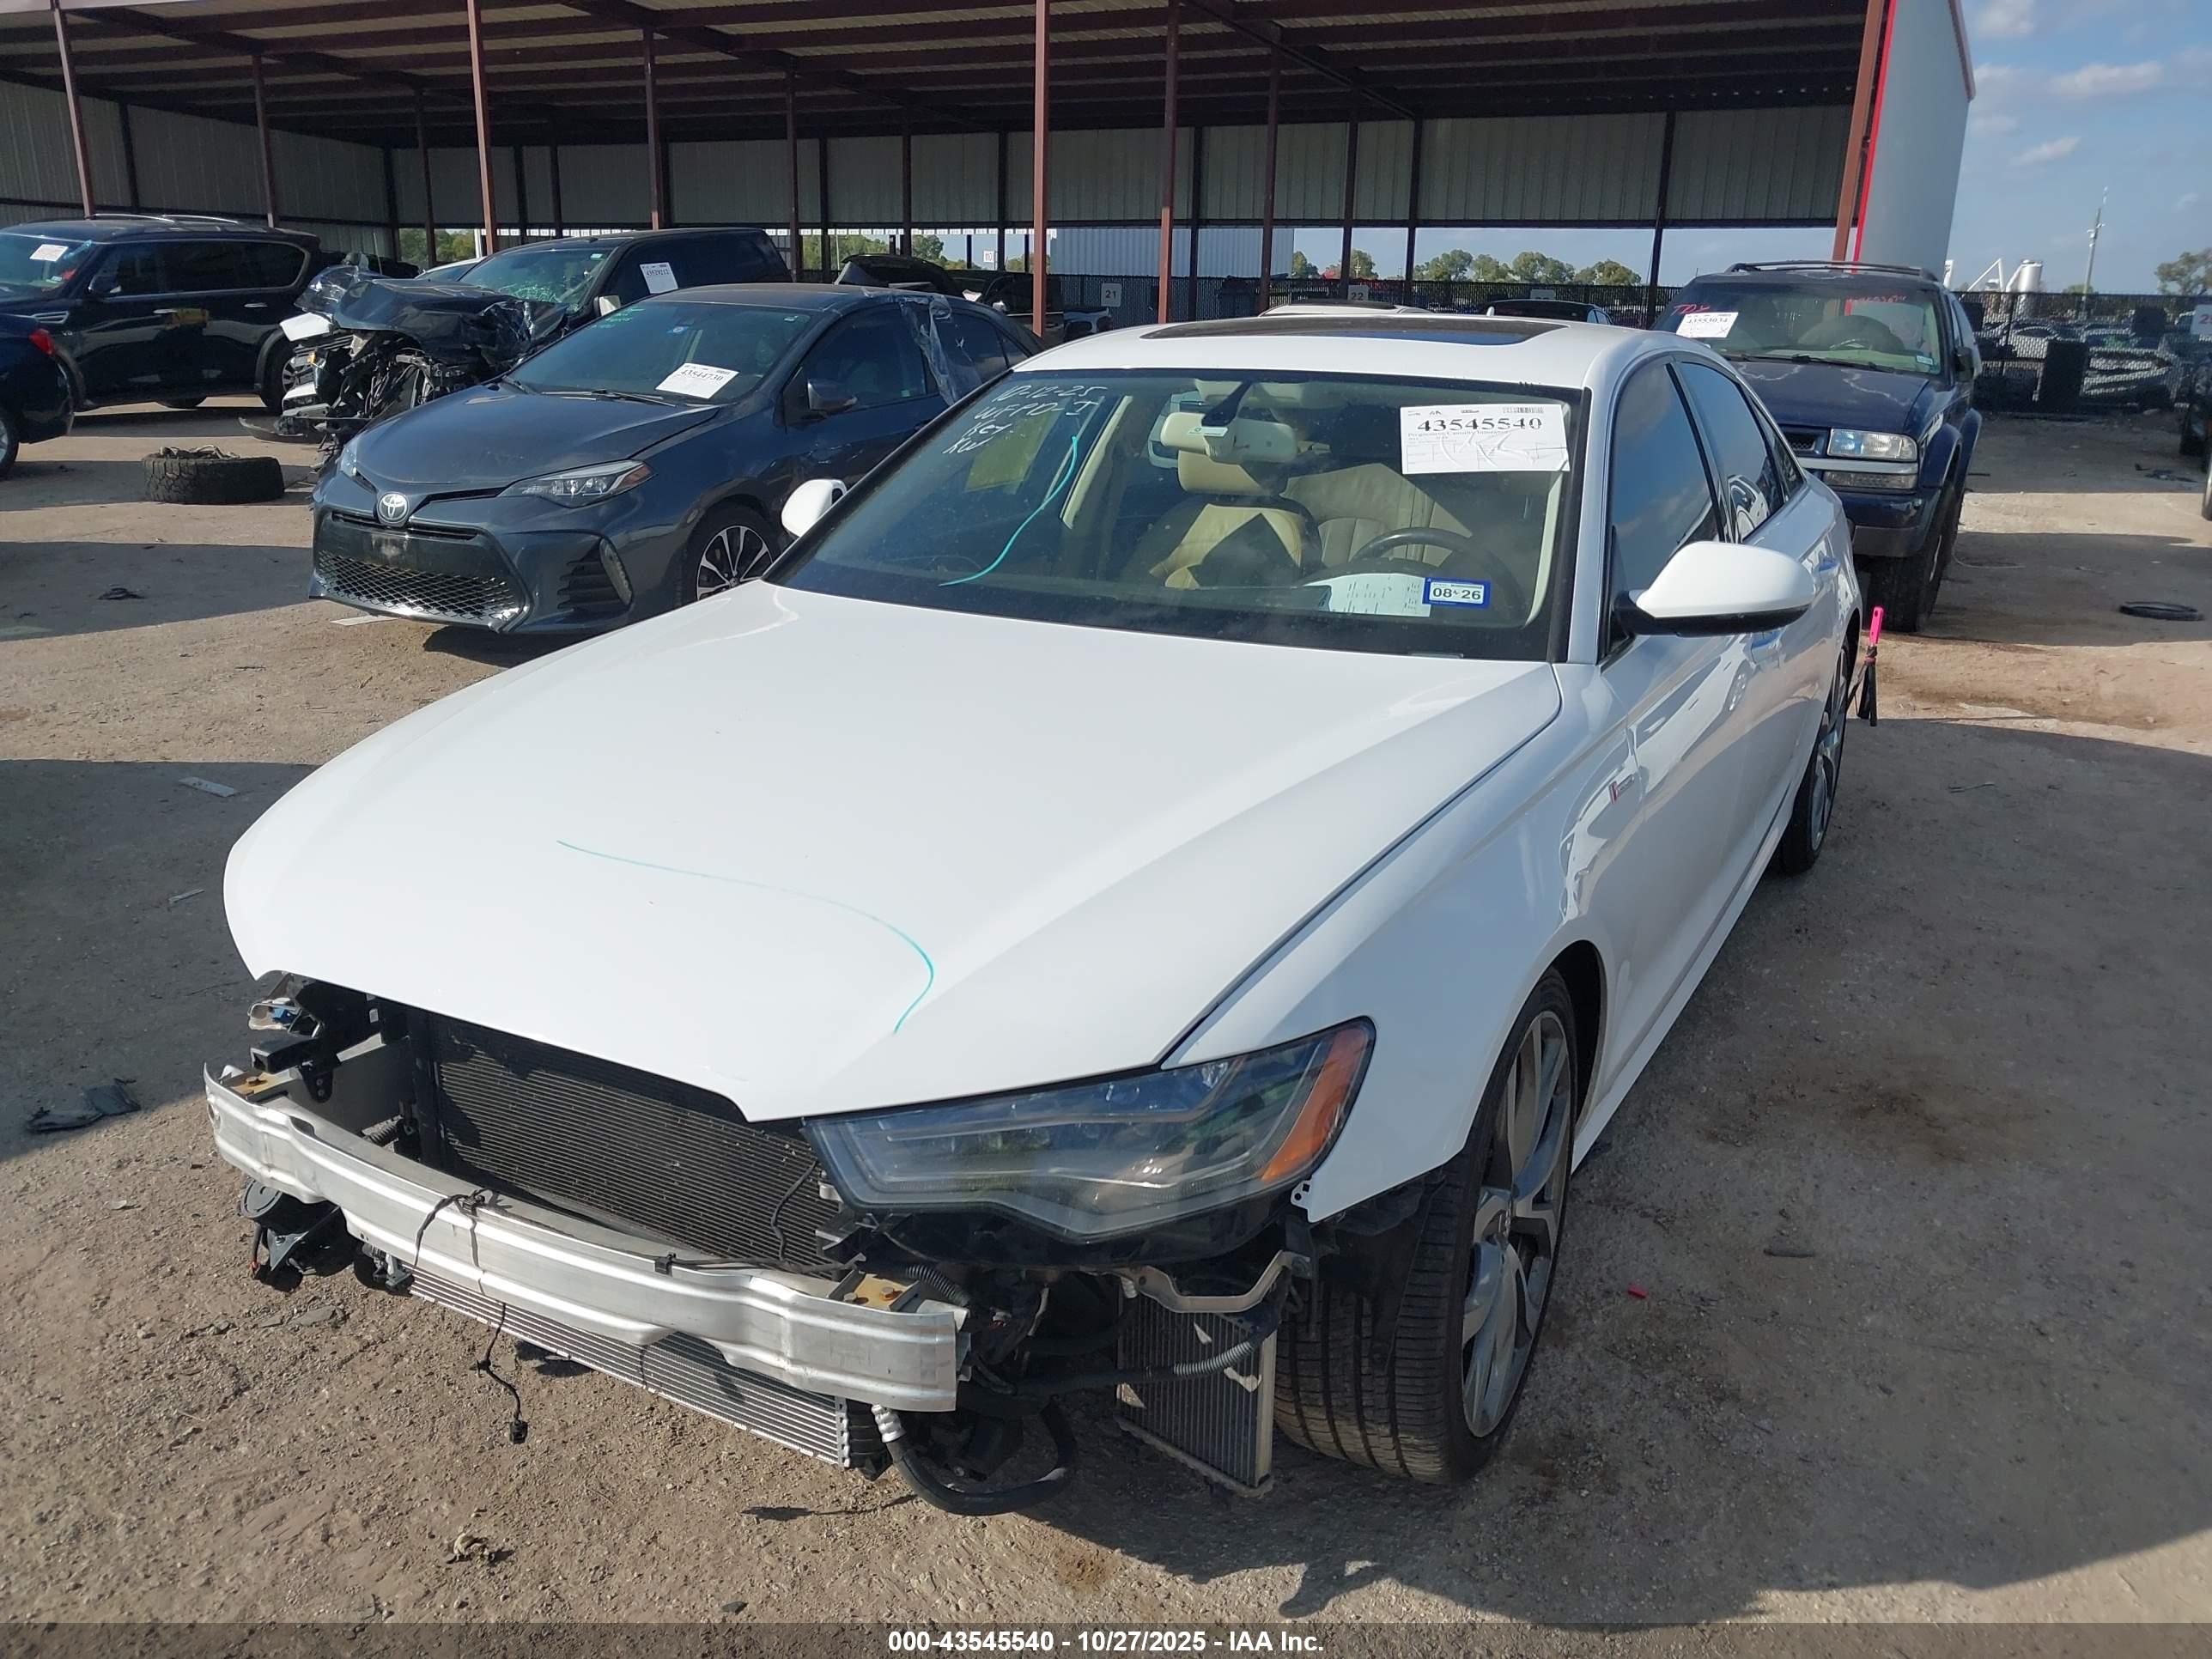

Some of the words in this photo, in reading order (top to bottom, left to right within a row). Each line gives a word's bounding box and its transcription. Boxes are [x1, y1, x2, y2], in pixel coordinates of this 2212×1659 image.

[1105, 289, 1116, 299] 21
[1351, 292, 1364, 301] 22
[1417, 417, 1543, 432] 43545540
[1432, 587, 1452, 598] 08
[1462, 589, 1481, 600] 26
